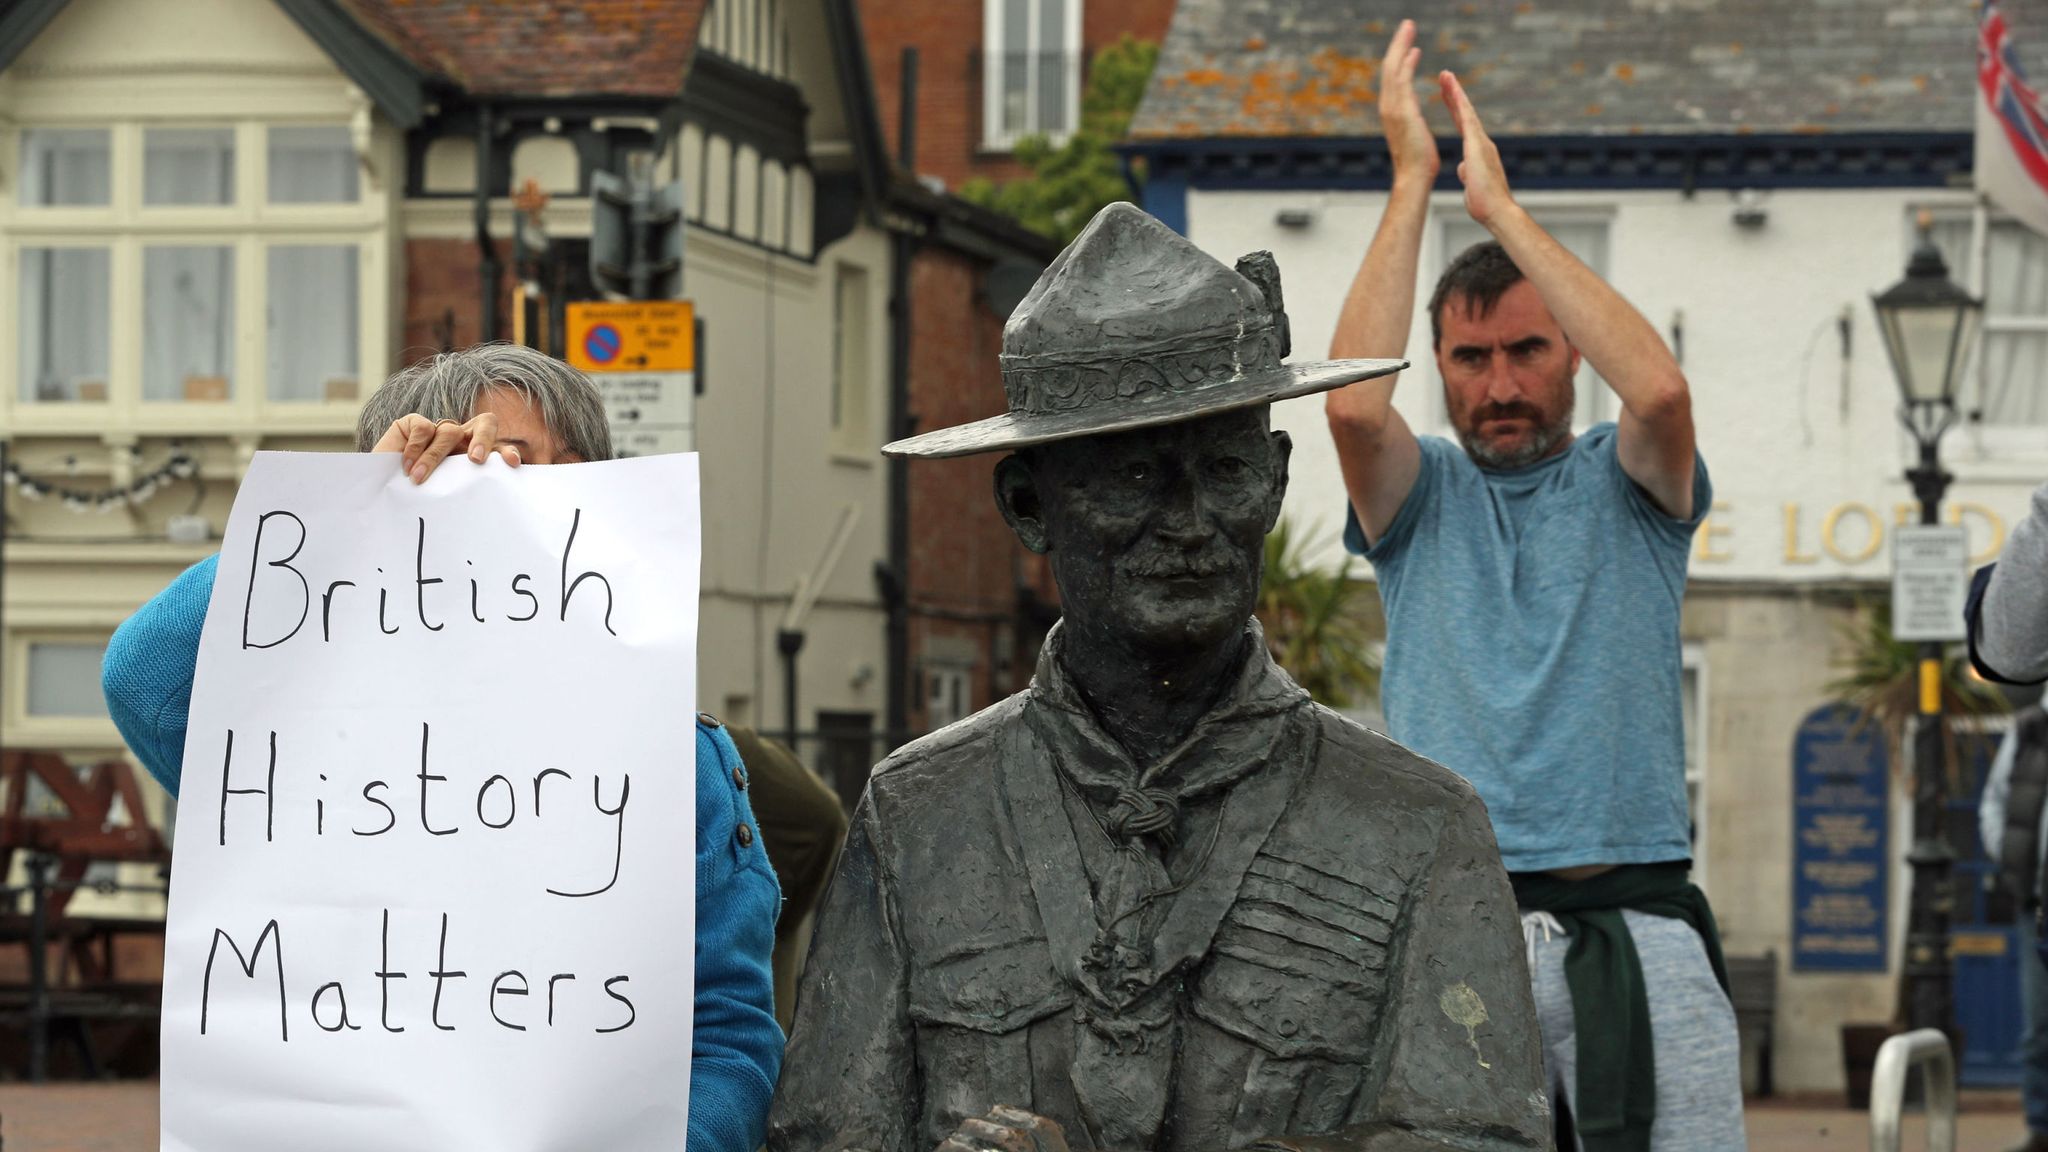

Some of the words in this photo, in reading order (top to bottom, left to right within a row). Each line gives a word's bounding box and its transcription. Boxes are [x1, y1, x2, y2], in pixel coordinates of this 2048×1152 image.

[242, 508, 617, 650] British
[219, 721, 630, 898] History
[200, 908, 637, 1043] Matters
